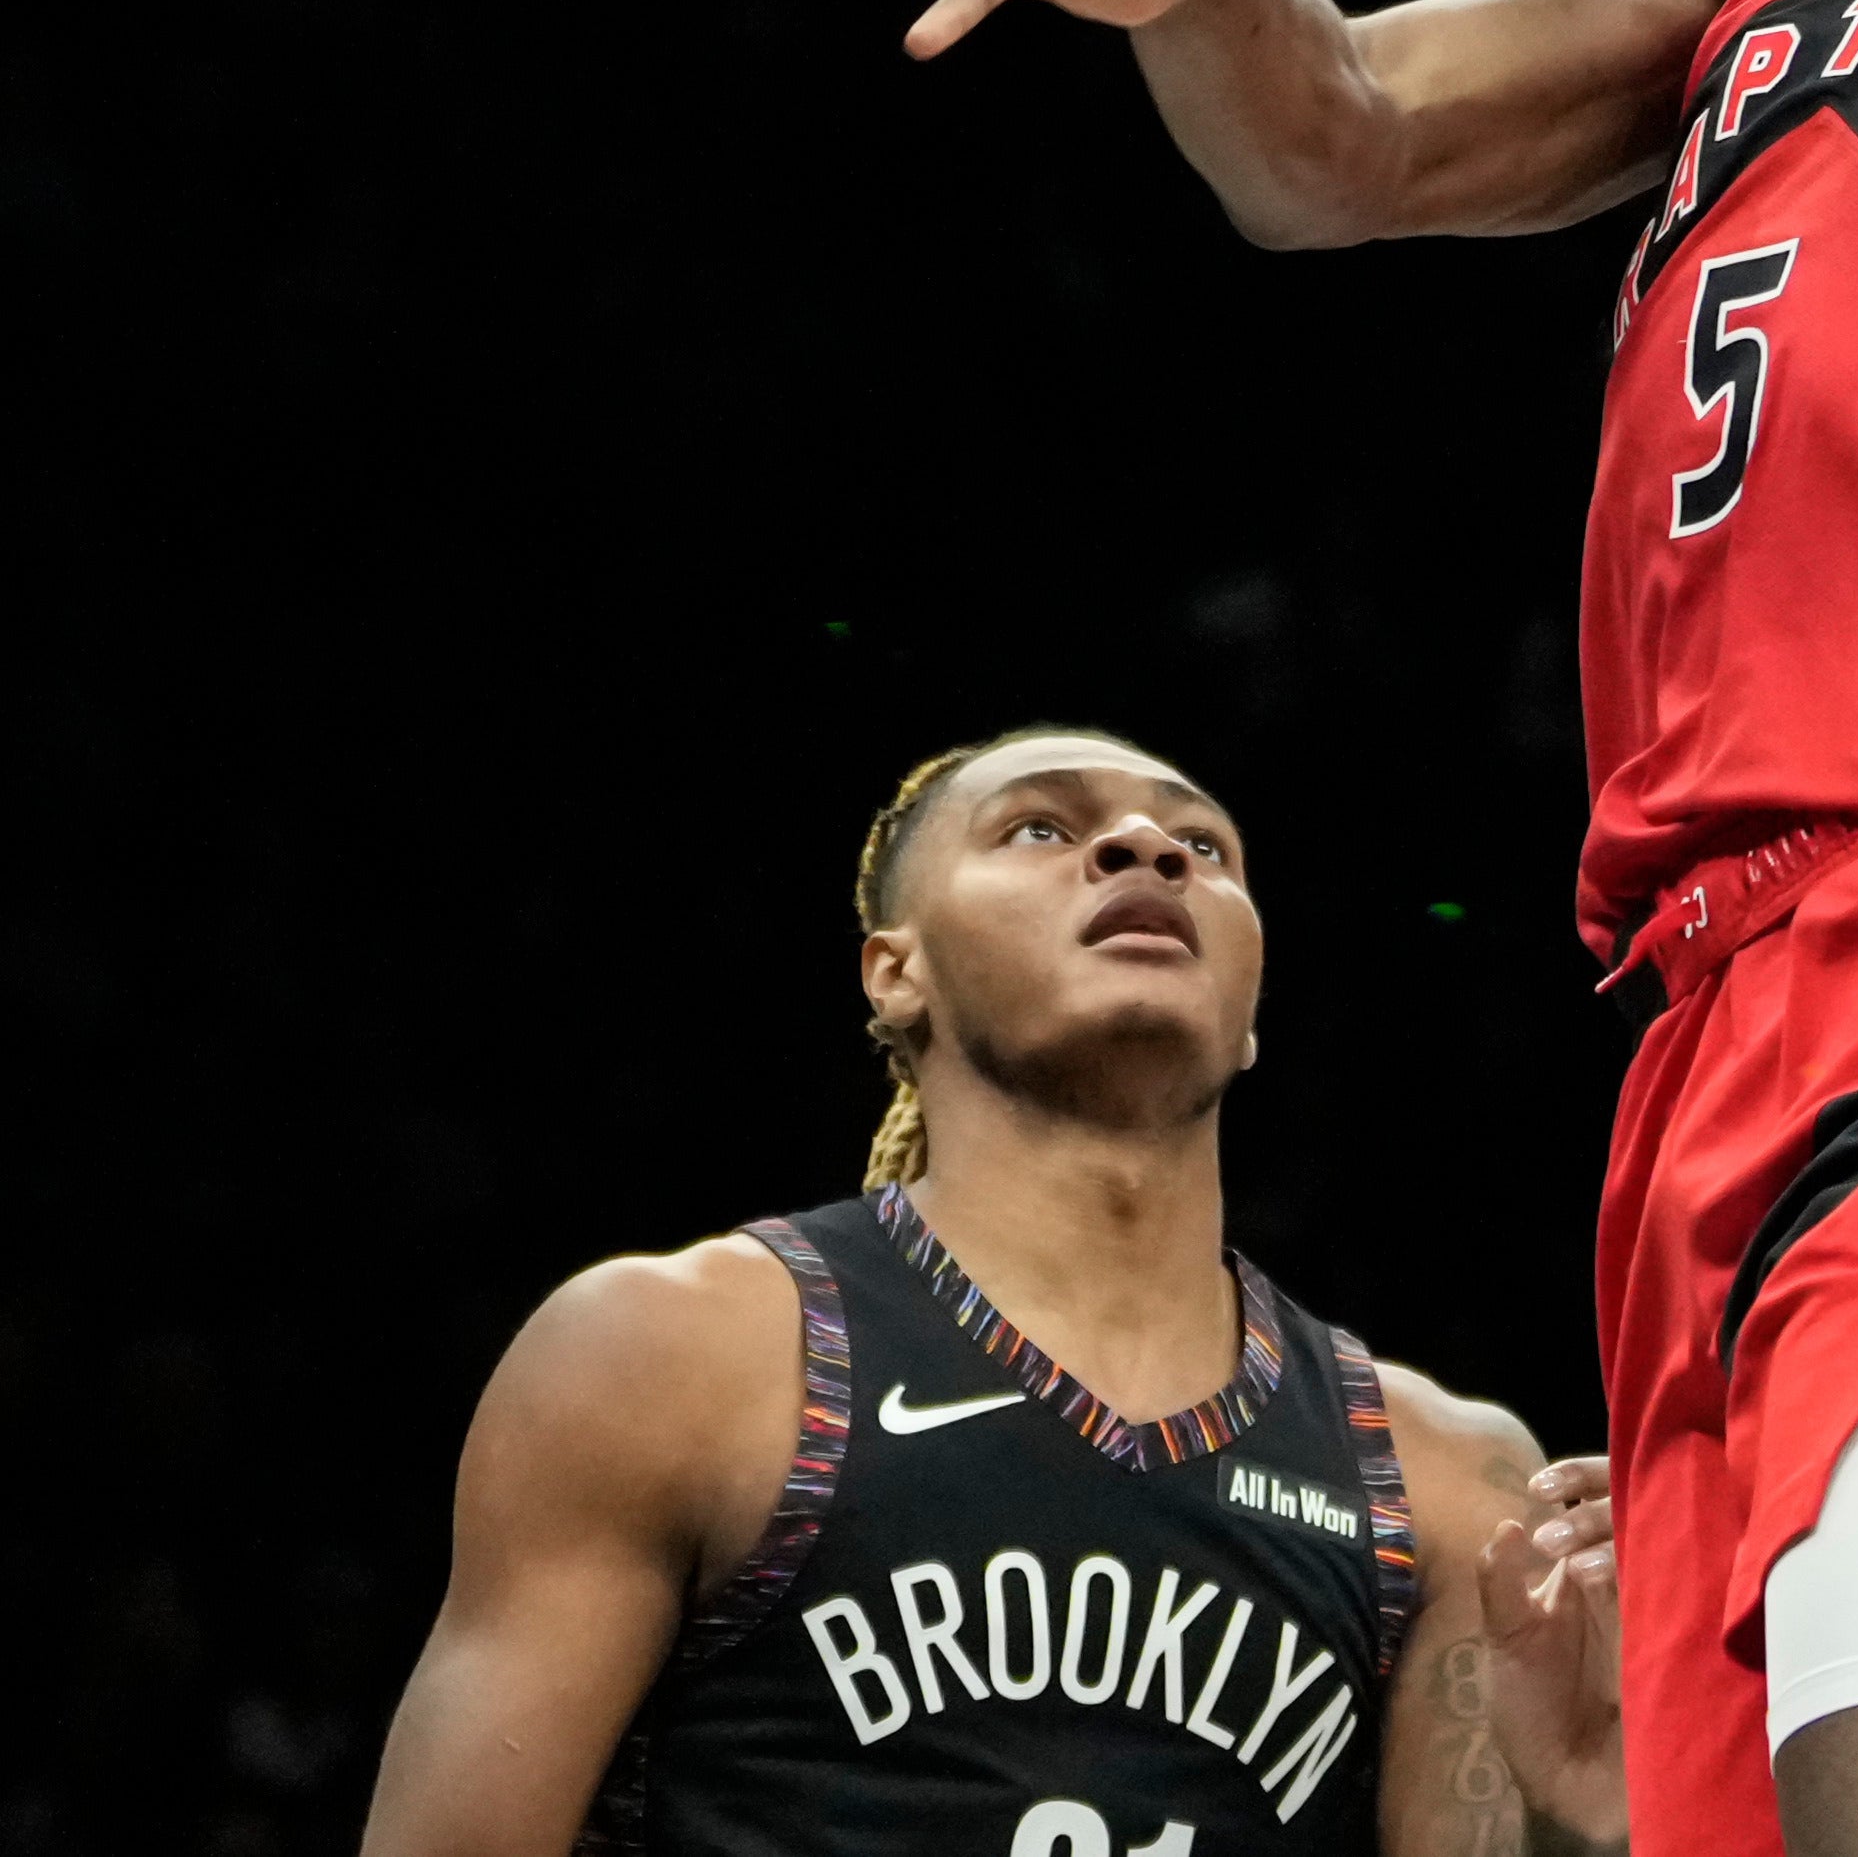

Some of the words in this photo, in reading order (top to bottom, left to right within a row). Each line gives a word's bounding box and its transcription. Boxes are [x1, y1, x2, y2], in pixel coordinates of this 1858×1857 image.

[1669, 238, 1799, 539] 5
[1229, 1466, 1265, 1510] All
[1271, 1478, 1297, 1519] In
[1300, 1487, 1357, 1539] Won
[803, 1548, 1357, 1824] BROOKLYN
